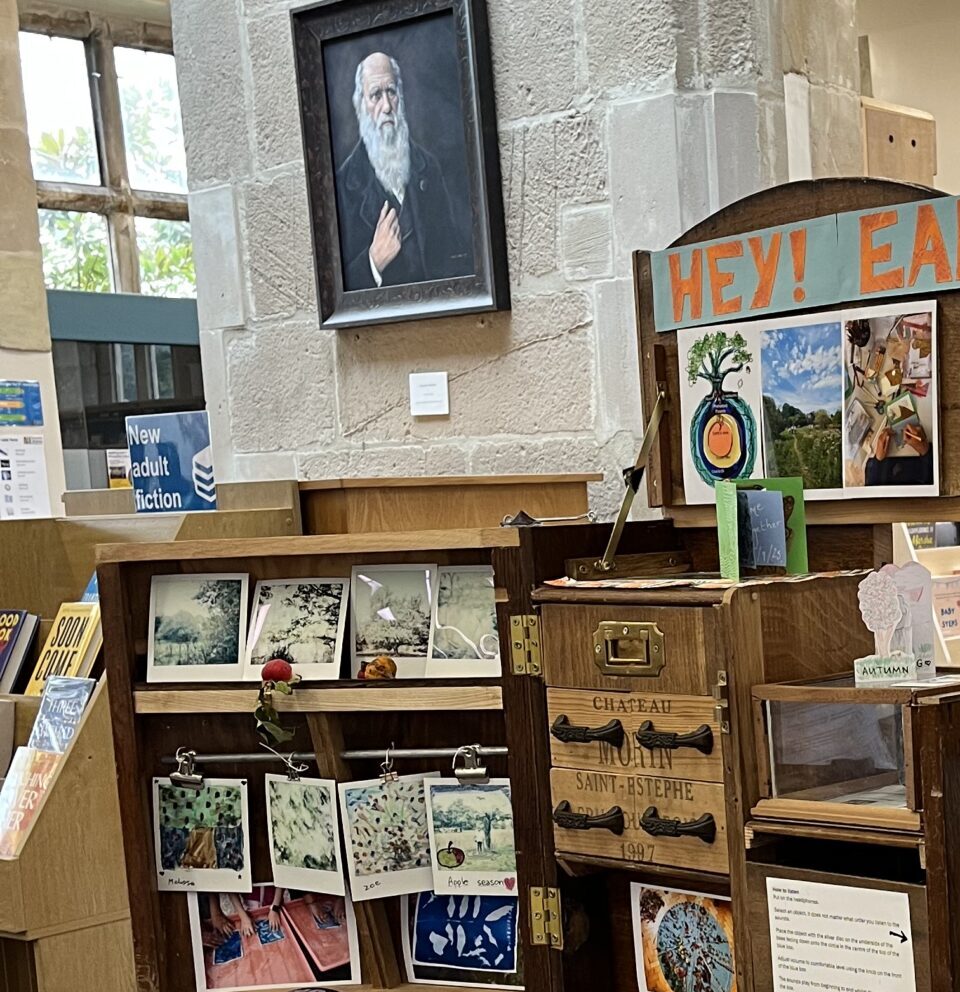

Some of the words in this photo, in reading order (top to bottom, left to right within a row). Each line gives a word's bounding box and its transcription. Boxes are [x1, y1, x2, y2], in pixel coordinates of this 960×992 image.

[667, 229, 806, 322] HEY!
[128, 425, 161, 445] New
[132, 456, 170, 477] adult
[135, 488, 182, 510] fiction
[941, 608, 955, 616] BABY
[50, 616, 90, 648] SOON
[35, 649, 77, 681] COME
[862, 666, 909, 676] AUTUMN
[593, 696, 672, 714] CHATEAU
[598, 730, 673, 770] MORIN
[619, 842, 656, 863] 1997
[448, 876, 469, 888] Apple
[477, 879, 504, 887] season
